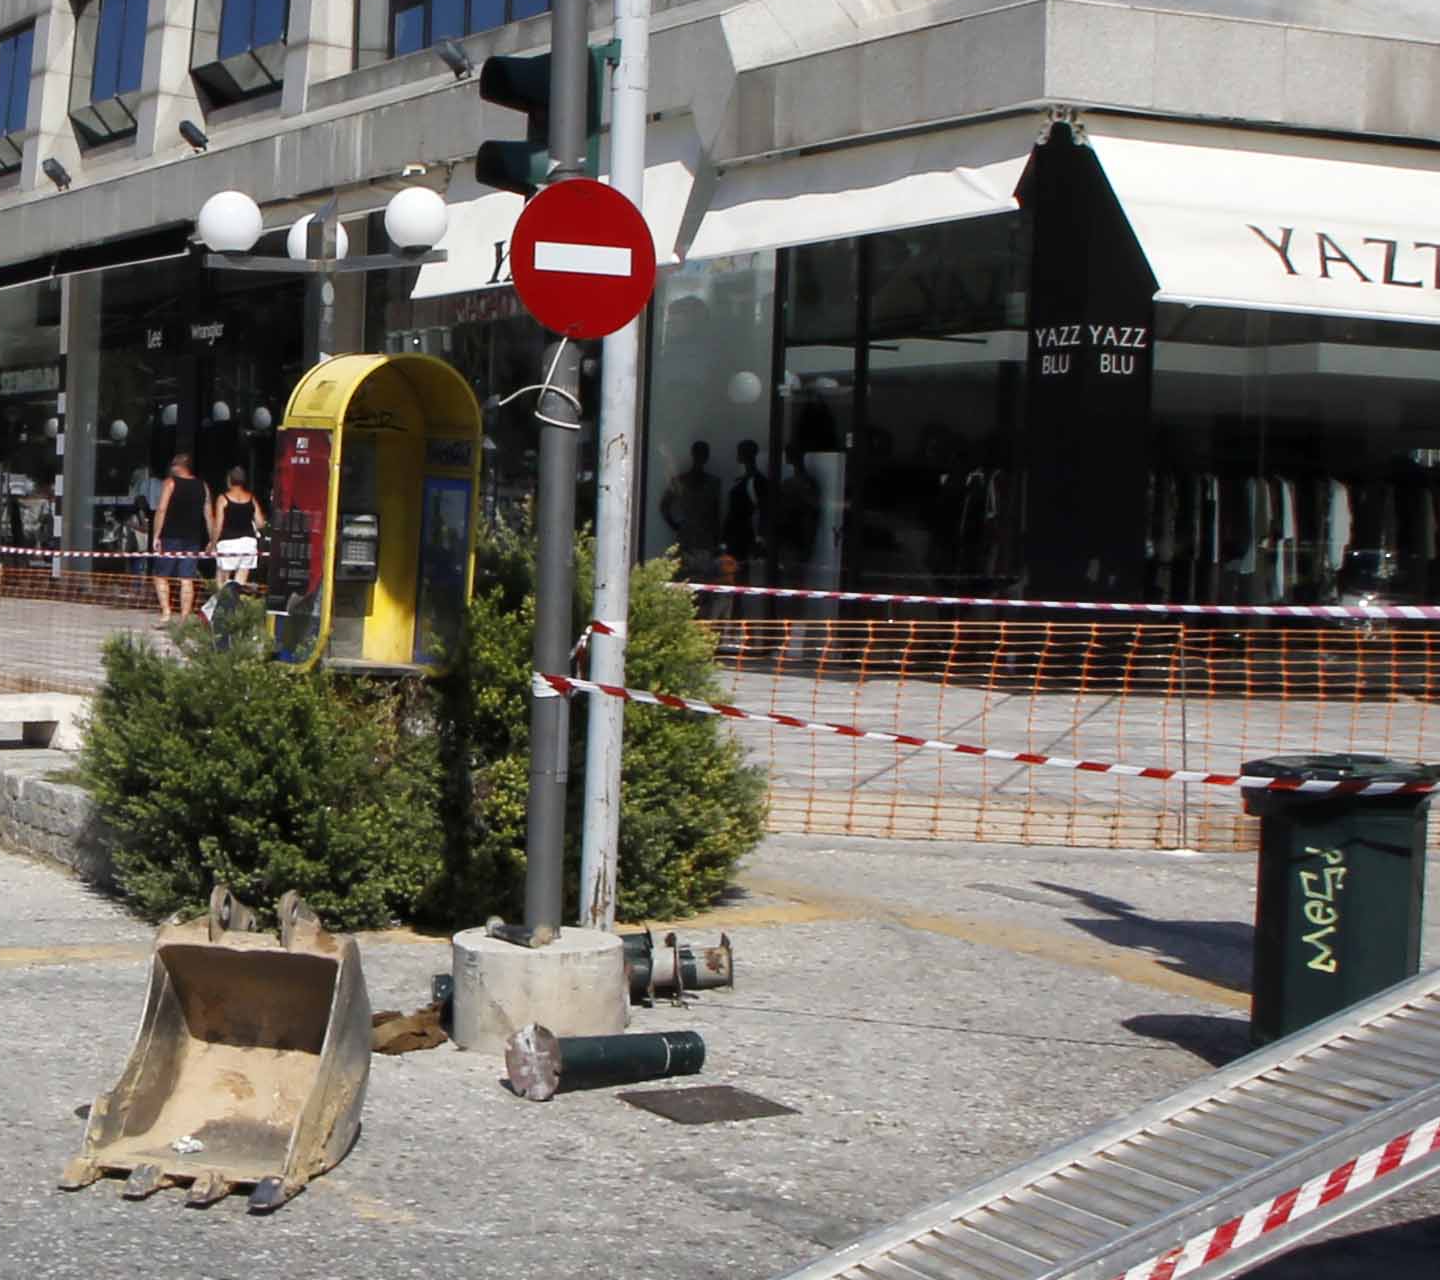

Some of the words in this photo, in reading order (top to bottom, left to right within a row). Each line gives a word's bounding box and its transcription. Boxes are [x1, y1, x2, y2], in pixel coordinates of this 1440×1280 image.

[1035, 325, 1081, 348] YAZZ
[1088, 324, 1147, 348] YAZZ
[1042, 354, 1071, 375] BLU
[1099, 353, 1135, 375] BLU
